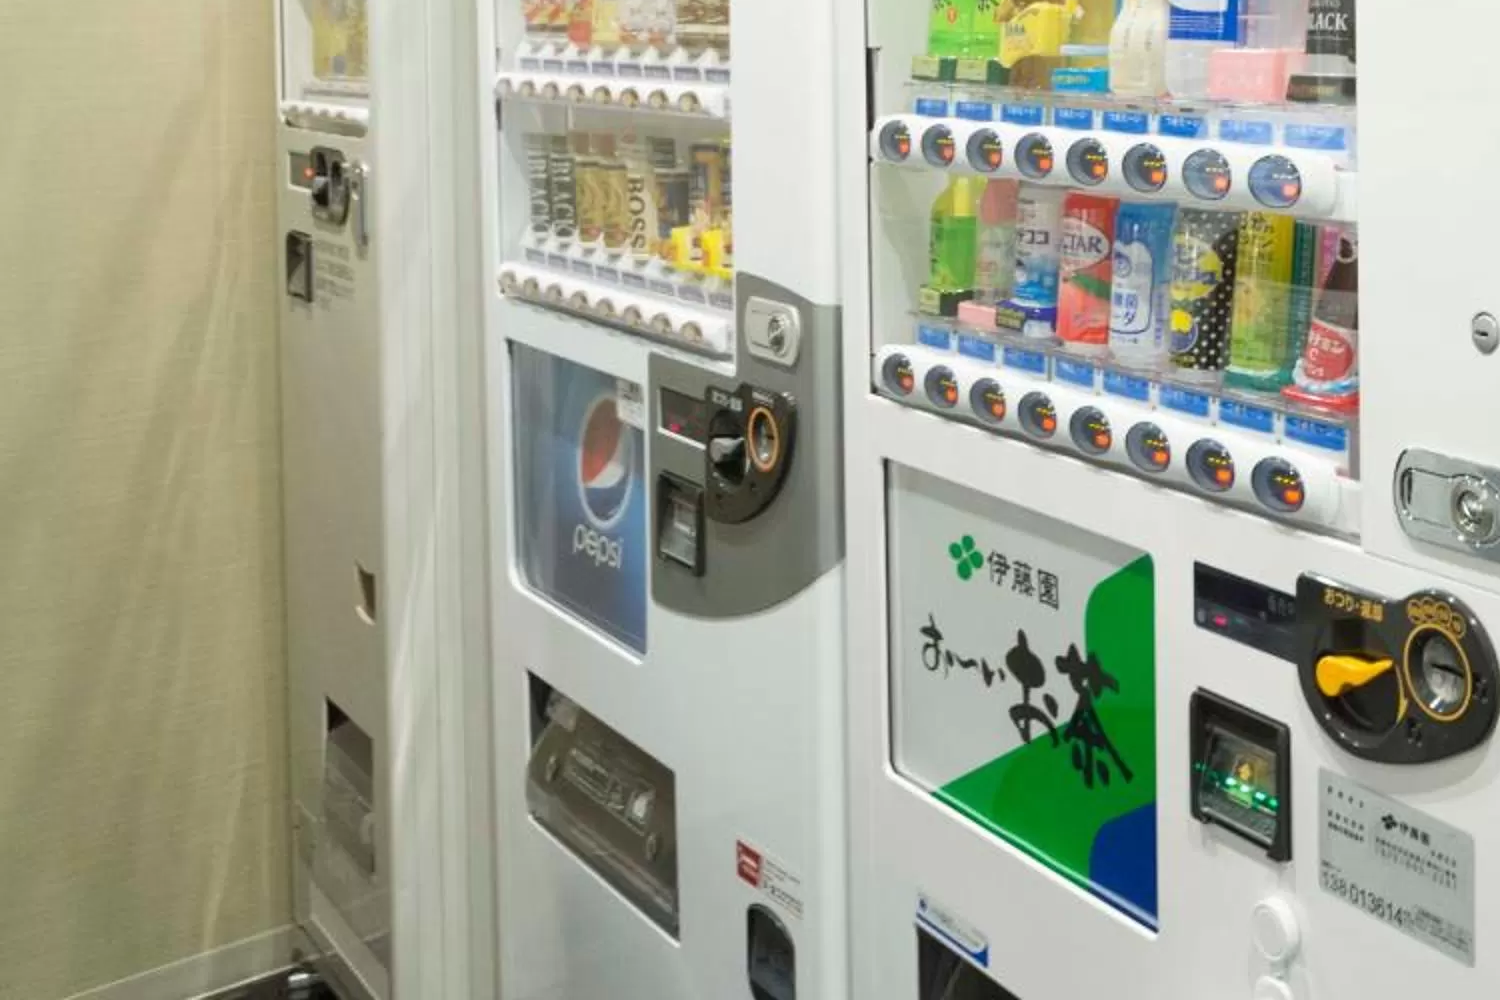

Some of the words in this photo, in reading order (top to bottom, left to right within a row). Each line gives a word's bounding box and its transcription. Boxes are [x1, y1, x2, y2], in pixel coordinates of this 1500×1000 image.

[627, 178, 646, 249] BOSS
[572, 523, 625, 569] pepsi
[987, 550, 1059, 610] 伊藤園
